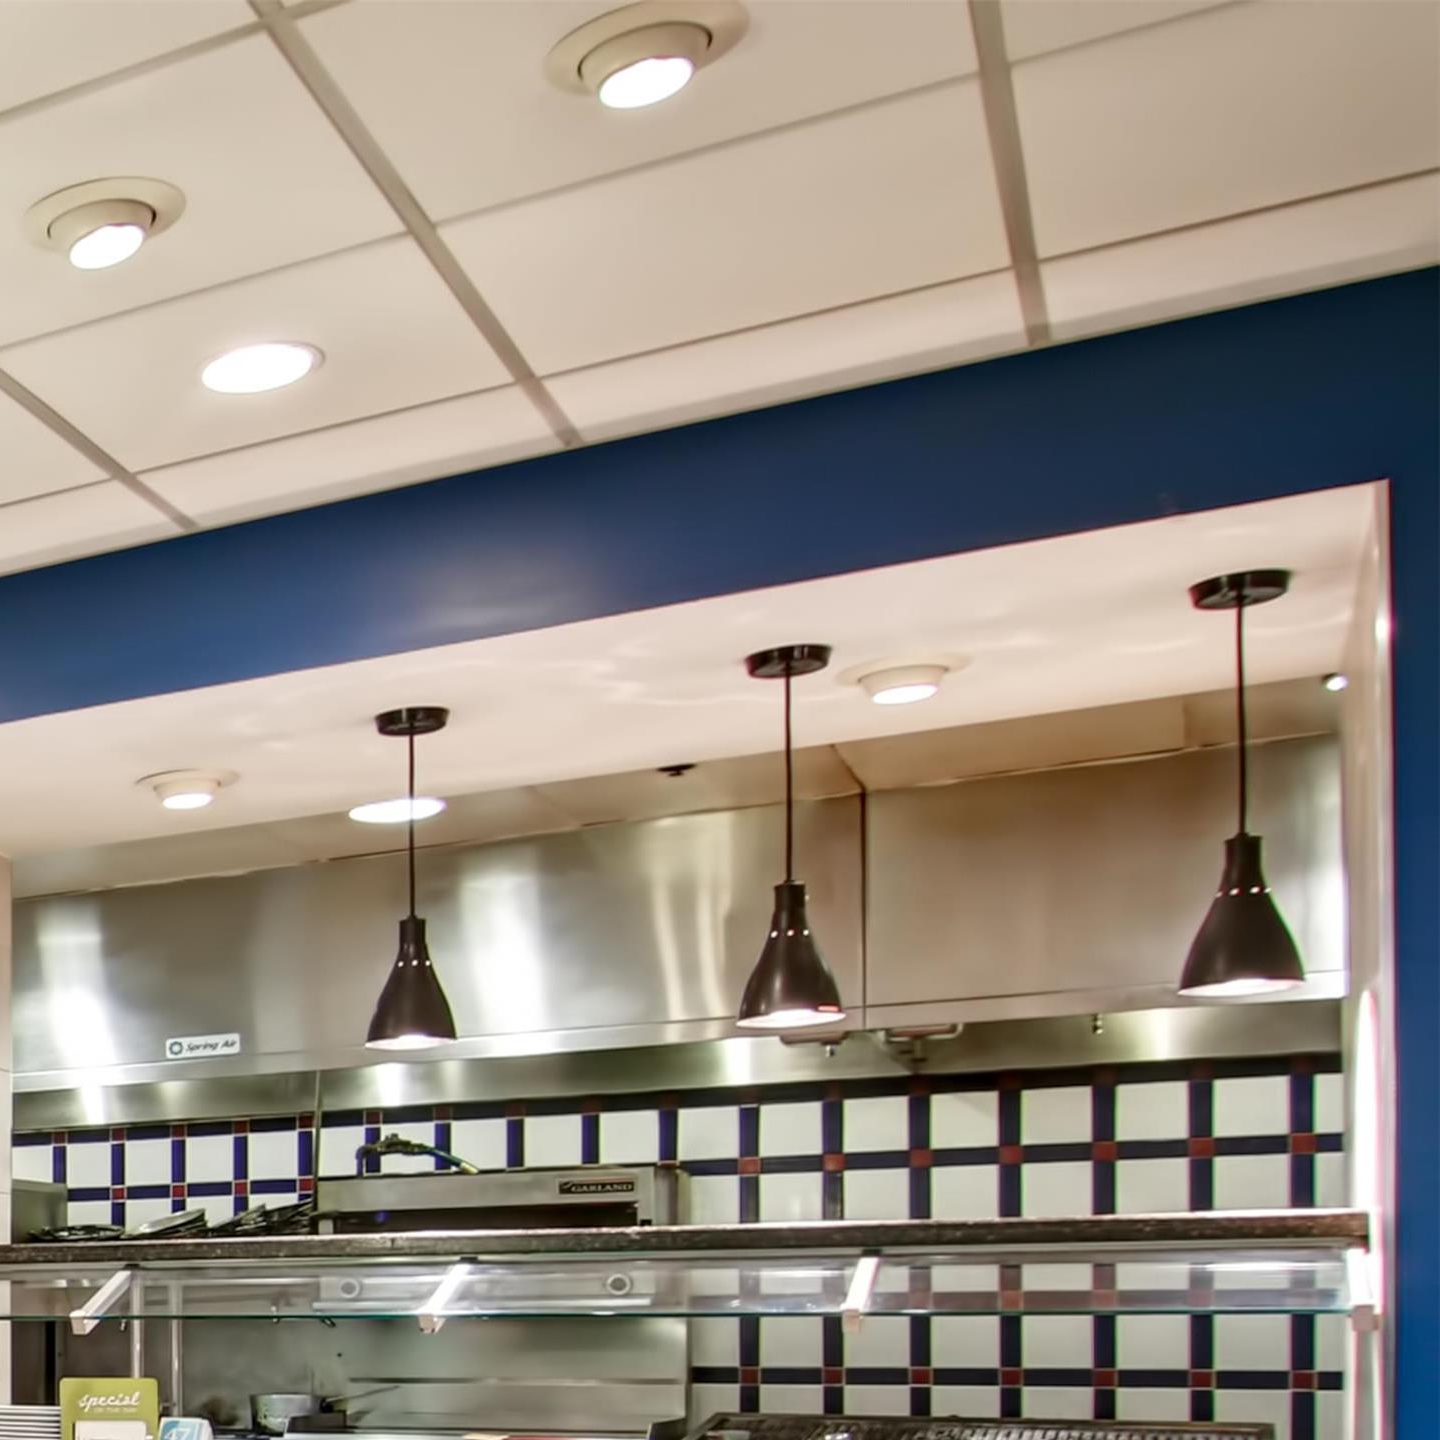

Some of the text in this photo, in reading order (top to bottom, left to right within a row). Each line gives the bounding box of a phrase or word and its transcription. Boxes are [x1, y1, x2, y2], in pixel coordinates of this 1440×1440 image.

[185, 1040, 236, 1052] Spring Air
[571, 1184, 632, 1192] GARLAND
[78, 1391, 141, 1413] special
